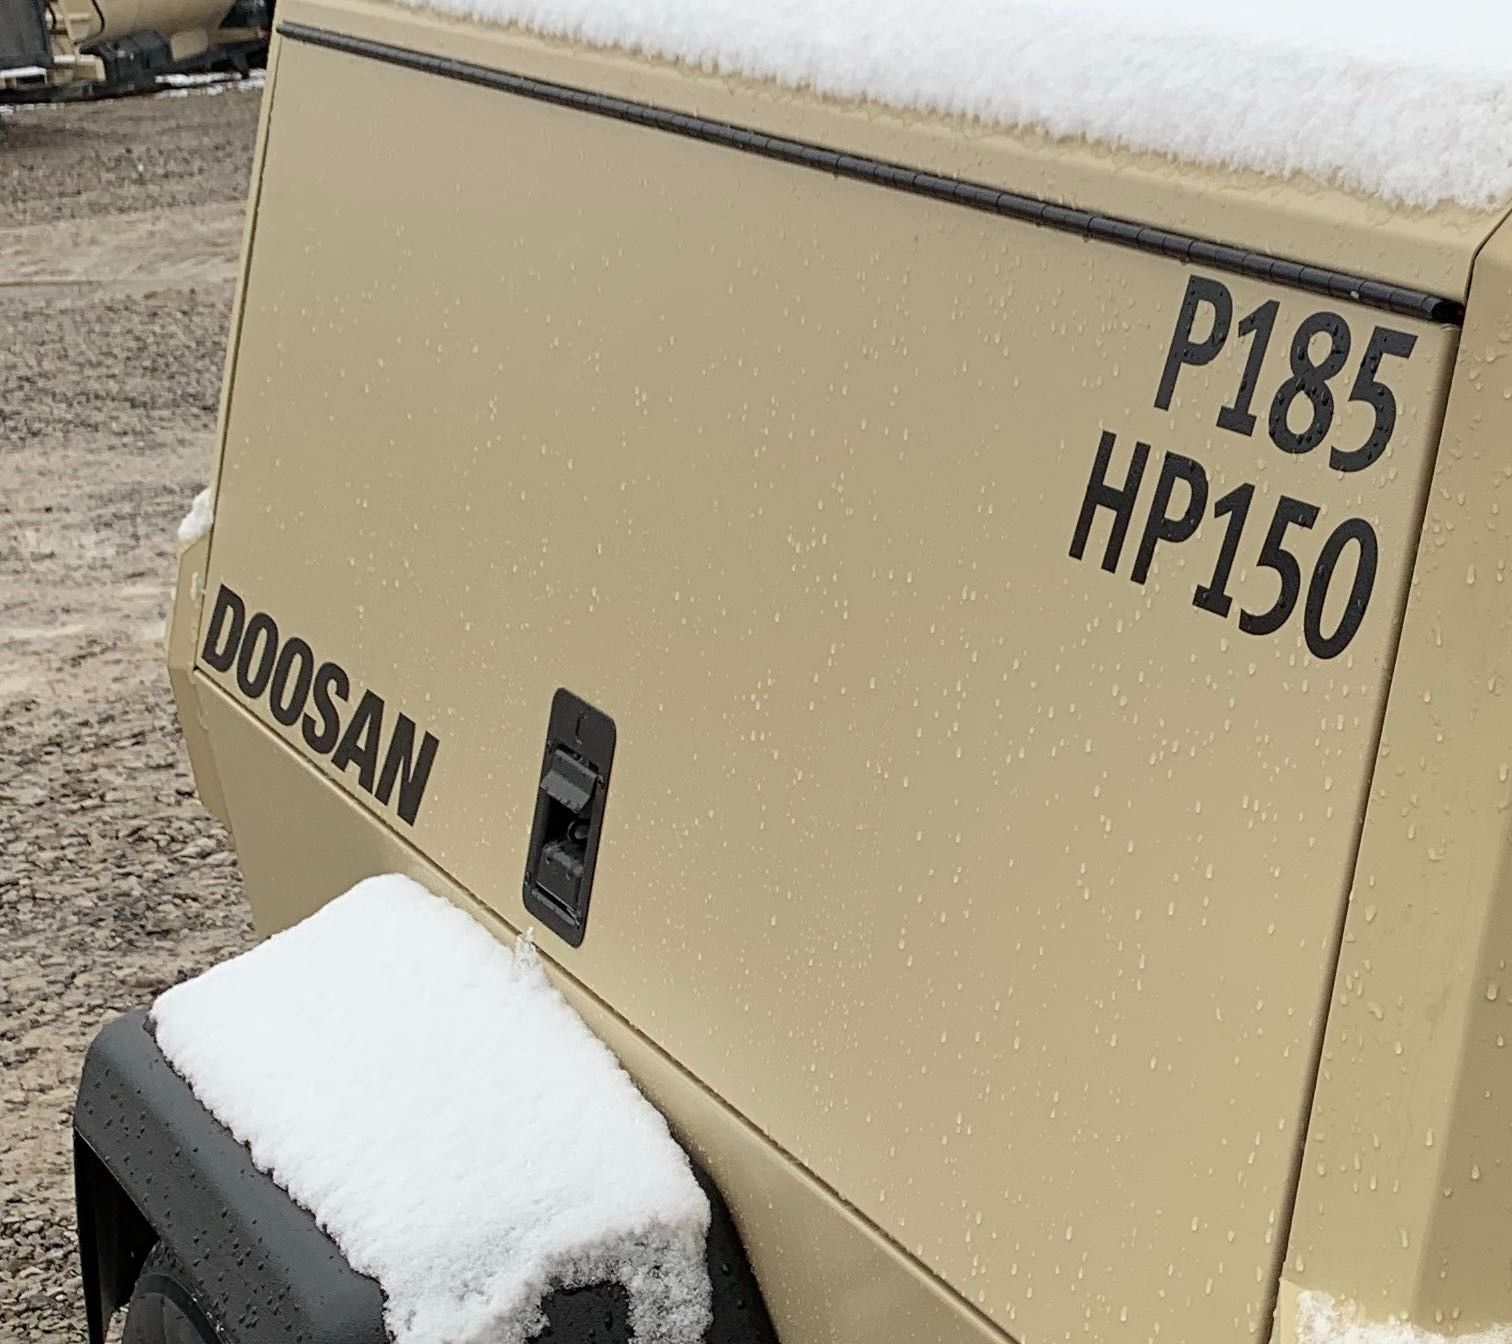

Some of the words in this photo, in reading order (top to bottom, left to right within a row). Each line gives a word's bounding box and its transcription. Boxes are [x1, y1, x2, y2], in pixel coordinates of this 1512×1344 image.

[1154, 275, 1418, 472] P185
[1069, 431, 1378, 659] HP150
[202, 584, 440, 827] DOOSAN
